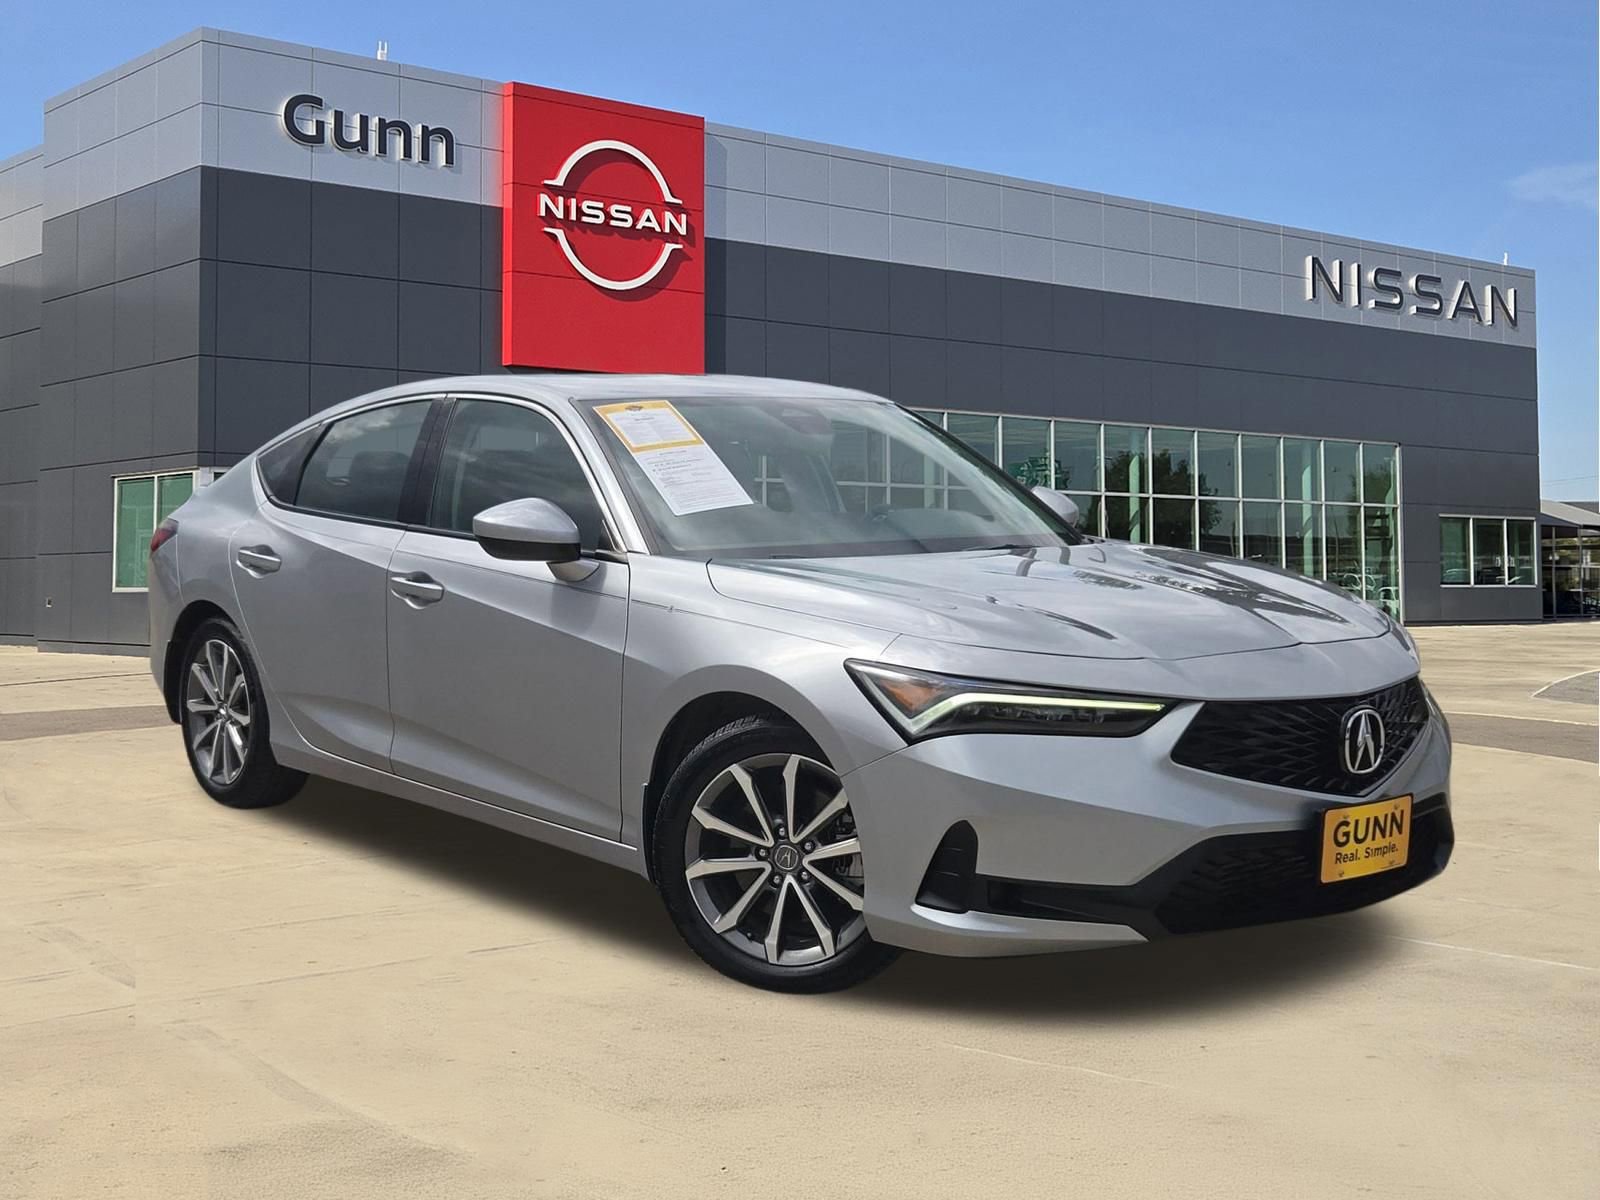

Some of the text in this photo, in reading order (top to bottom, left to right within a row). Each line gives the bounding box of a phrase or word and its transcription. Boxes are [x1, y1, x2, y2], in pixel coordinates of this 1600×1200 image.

[282, 93, 456, 168] Gunn
[537, 192, 688, 236] NISSAN
[1305, 255, 1518, 328] NISSAN
[1333, 808, 1405, 848] GUNN
[1334, 841, 1399, 865] Real. Simple.
